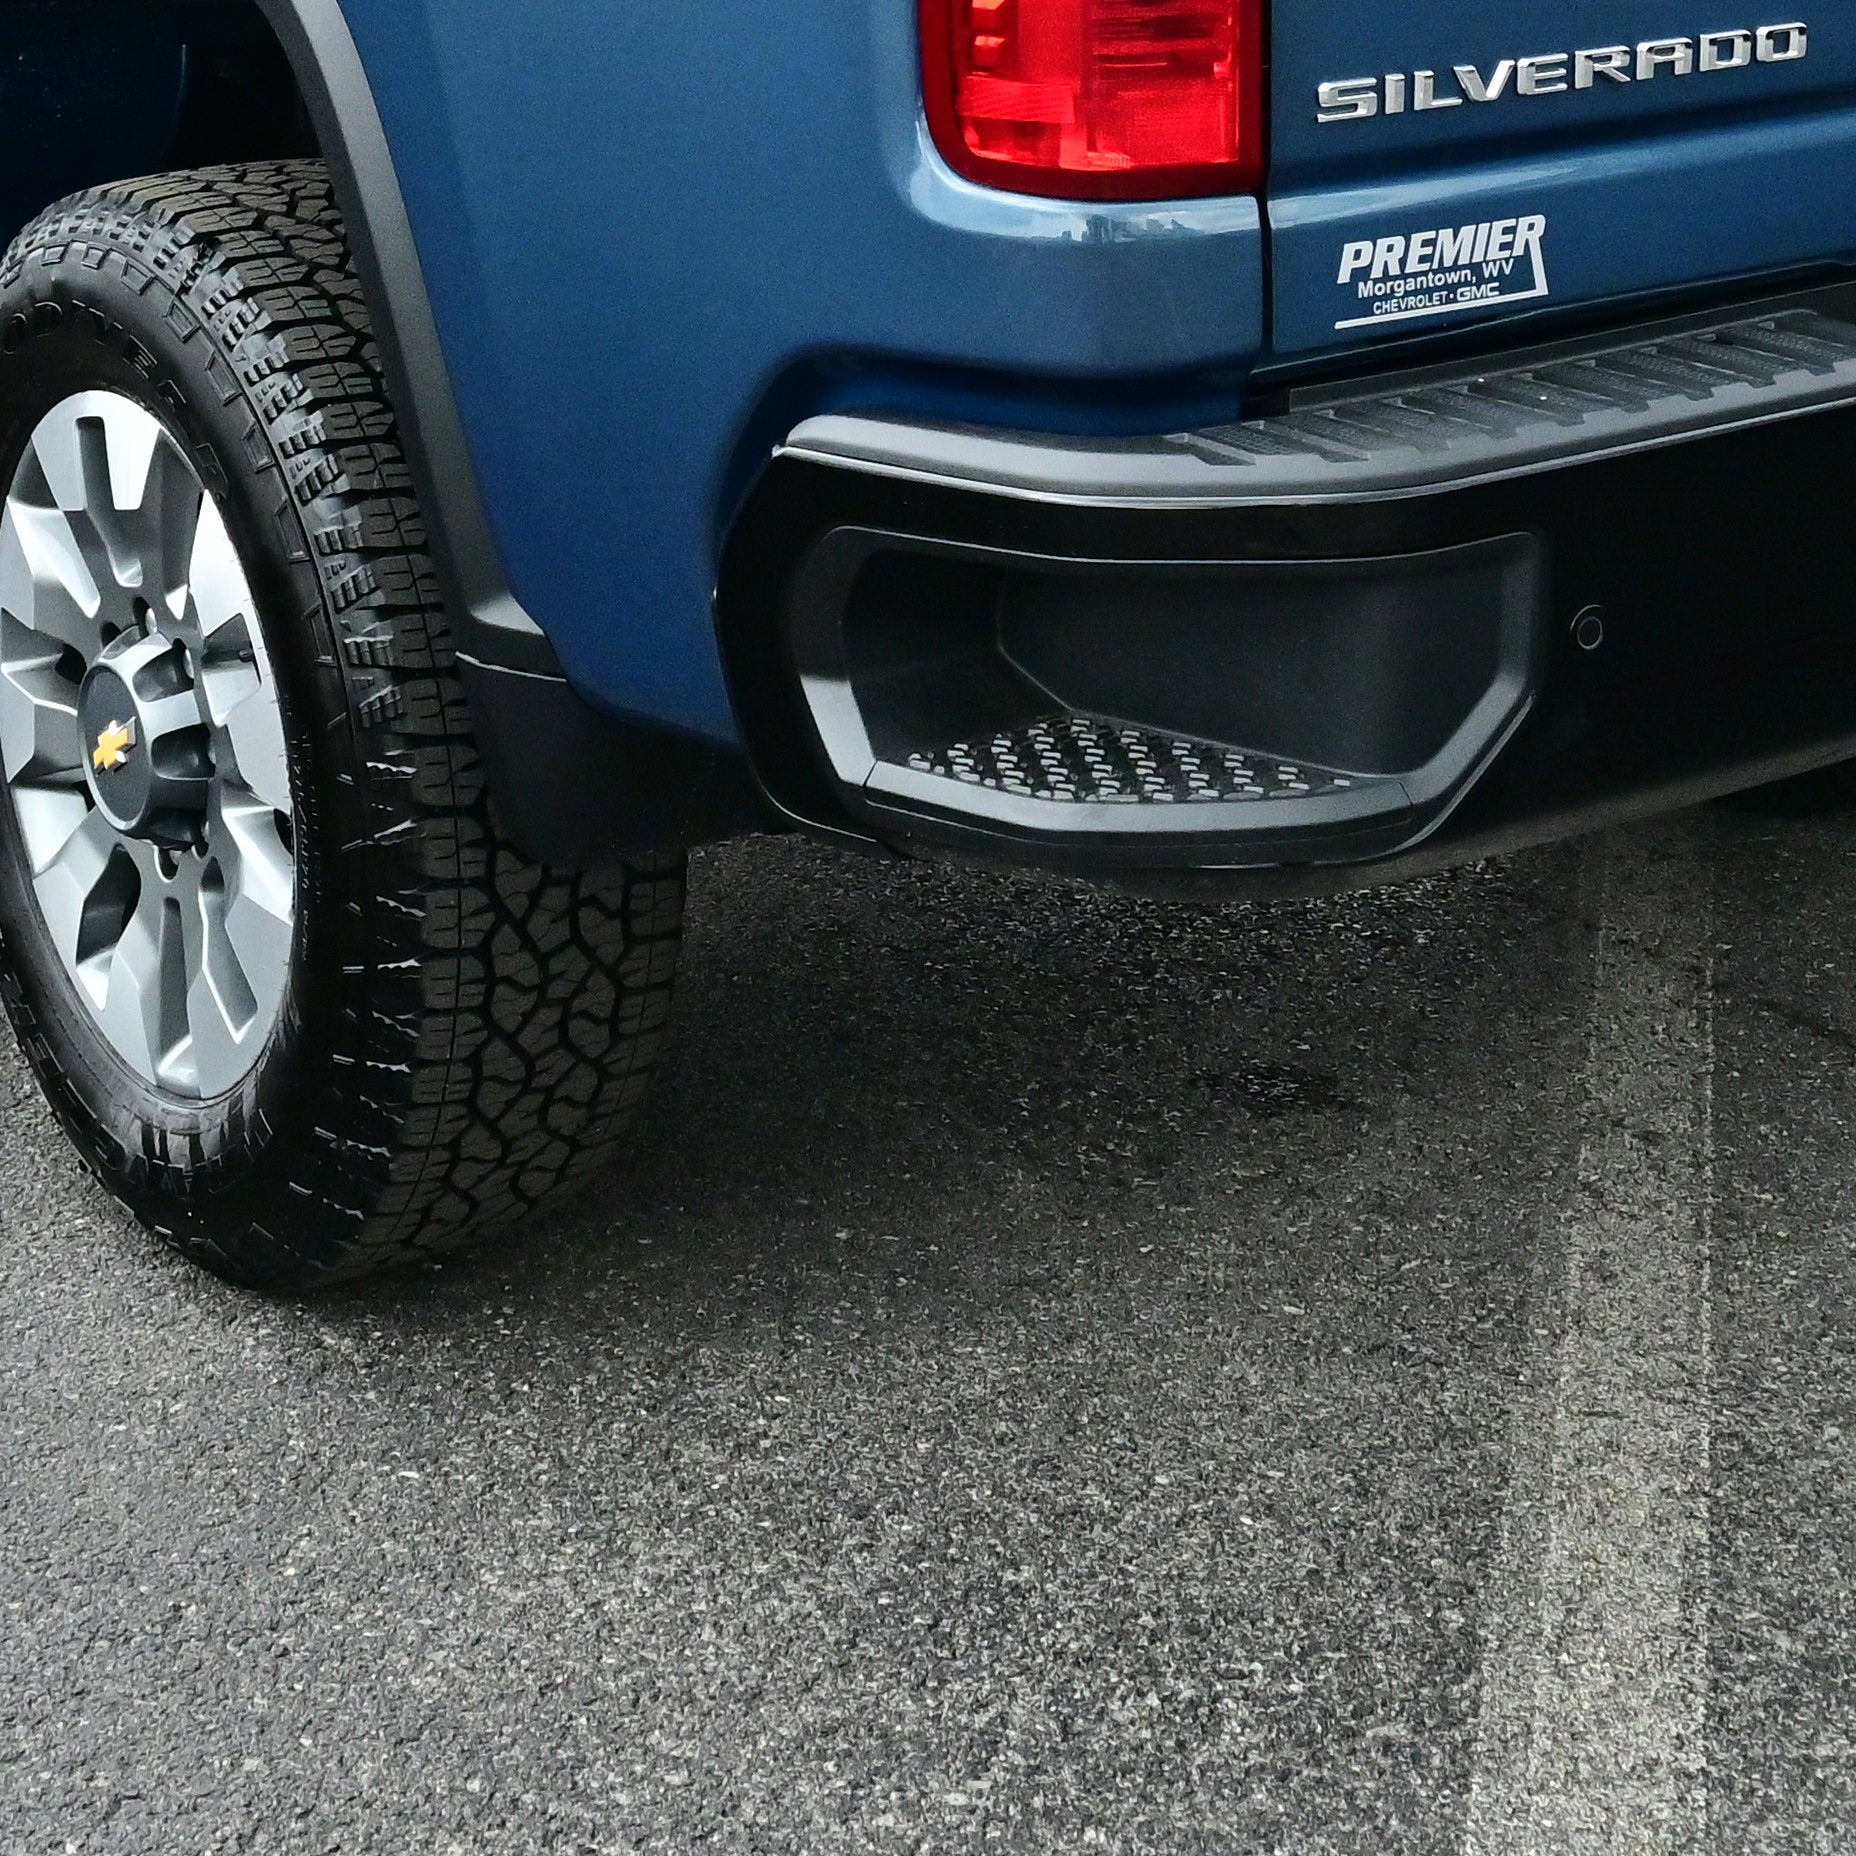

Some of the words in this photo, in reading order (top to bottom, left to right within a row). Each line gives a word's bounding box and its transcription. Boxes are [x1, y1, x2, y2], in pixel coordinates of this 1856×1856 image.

[1316, 21, 1809, 124] SILVERADO
[1336, 213, 1547, 286] PREMIER
[1357, 266, 1477, 299] Morgantown,
[1482, 258, 1515, 279] WV
[1372, 290, 1448, 315] CHEVROLET
[1456, 282, 1500, 302] GMC
